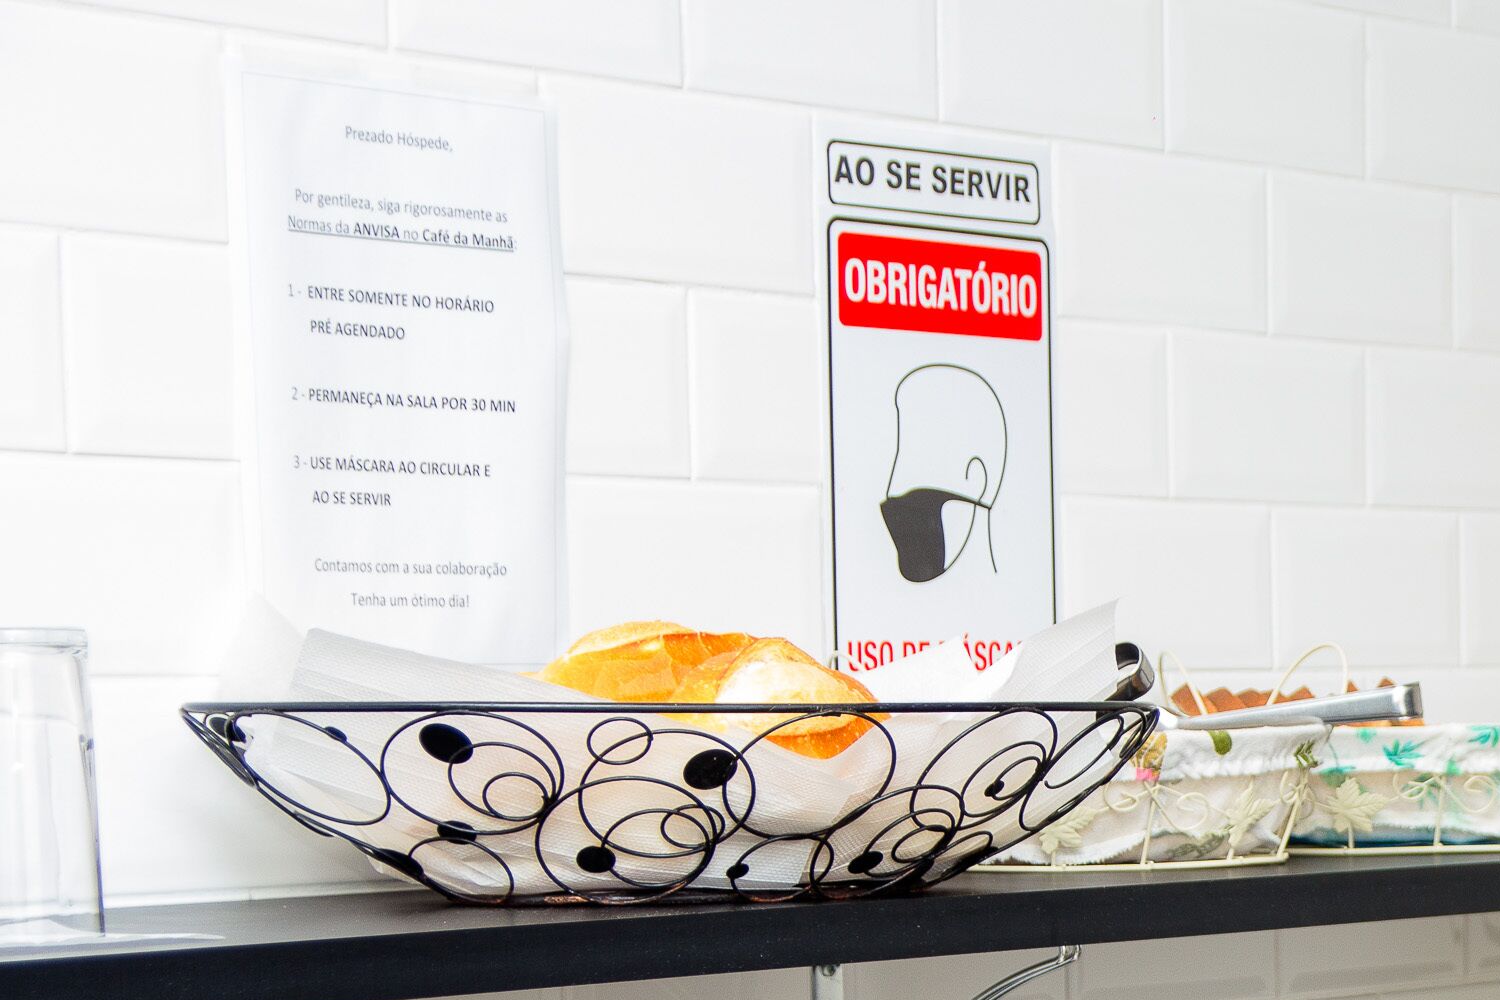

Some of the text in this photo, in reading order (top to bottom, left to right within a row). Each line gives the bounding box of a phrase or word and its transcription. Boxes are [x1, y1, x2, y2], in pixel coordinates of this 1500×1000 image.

[345, 125, 453, 152] Prezado Hóspede,
[834, 155, 1030, 203] AO SE SERVIR
[295, 188, 508, 223] Por gentileza, siga rigorosamente as
[288, 215, 332, 234] Normas
[335, 221, 350, 235] da
[353, 222, 400, 239] ANVISA
[403, 229, 419, 241] no
[422, 228, 449, 244] Café
[453, 231, 468, 245] da
[307, 285, 345, 302] ENTRE
[348, 288, 408, 307] SOMENTE
[411, 294, 431, 309] NO
[435, 295, 495, 314] HORÁRIO
[844, 257, 1038, 318] OBRIGATÓRIO
[310, 317, 405, 341] PRÉ AGENDADO
[291, 386, 299, 401] 2
[308, 387, 383, 408] PERMANEÇA
[386, 393, 404, 407] NA
[407, 394, 438, 409] SALA
[441, 396, 467, 411] POR
[471, 397, 487, 412] 30
[490, 399, 516, 413] MIN
[293, 454, 300, 469] 3
[310, 455, 332, 471] USE
[335, 454, 395, 474] MÁSCARA
[398, 460, 416, 475] AO
[420, 461, 480, 478] CIRCULAR
[484, 463, 491, 477] E
[312, 490, 391, 507] AO SE SERVIR
[314, 557, 507, 579] Contamos com a sua colaboração
[350, 592, 470, 609] Tenha um ótimo dia!
[847, 639, 894, 672] USO
